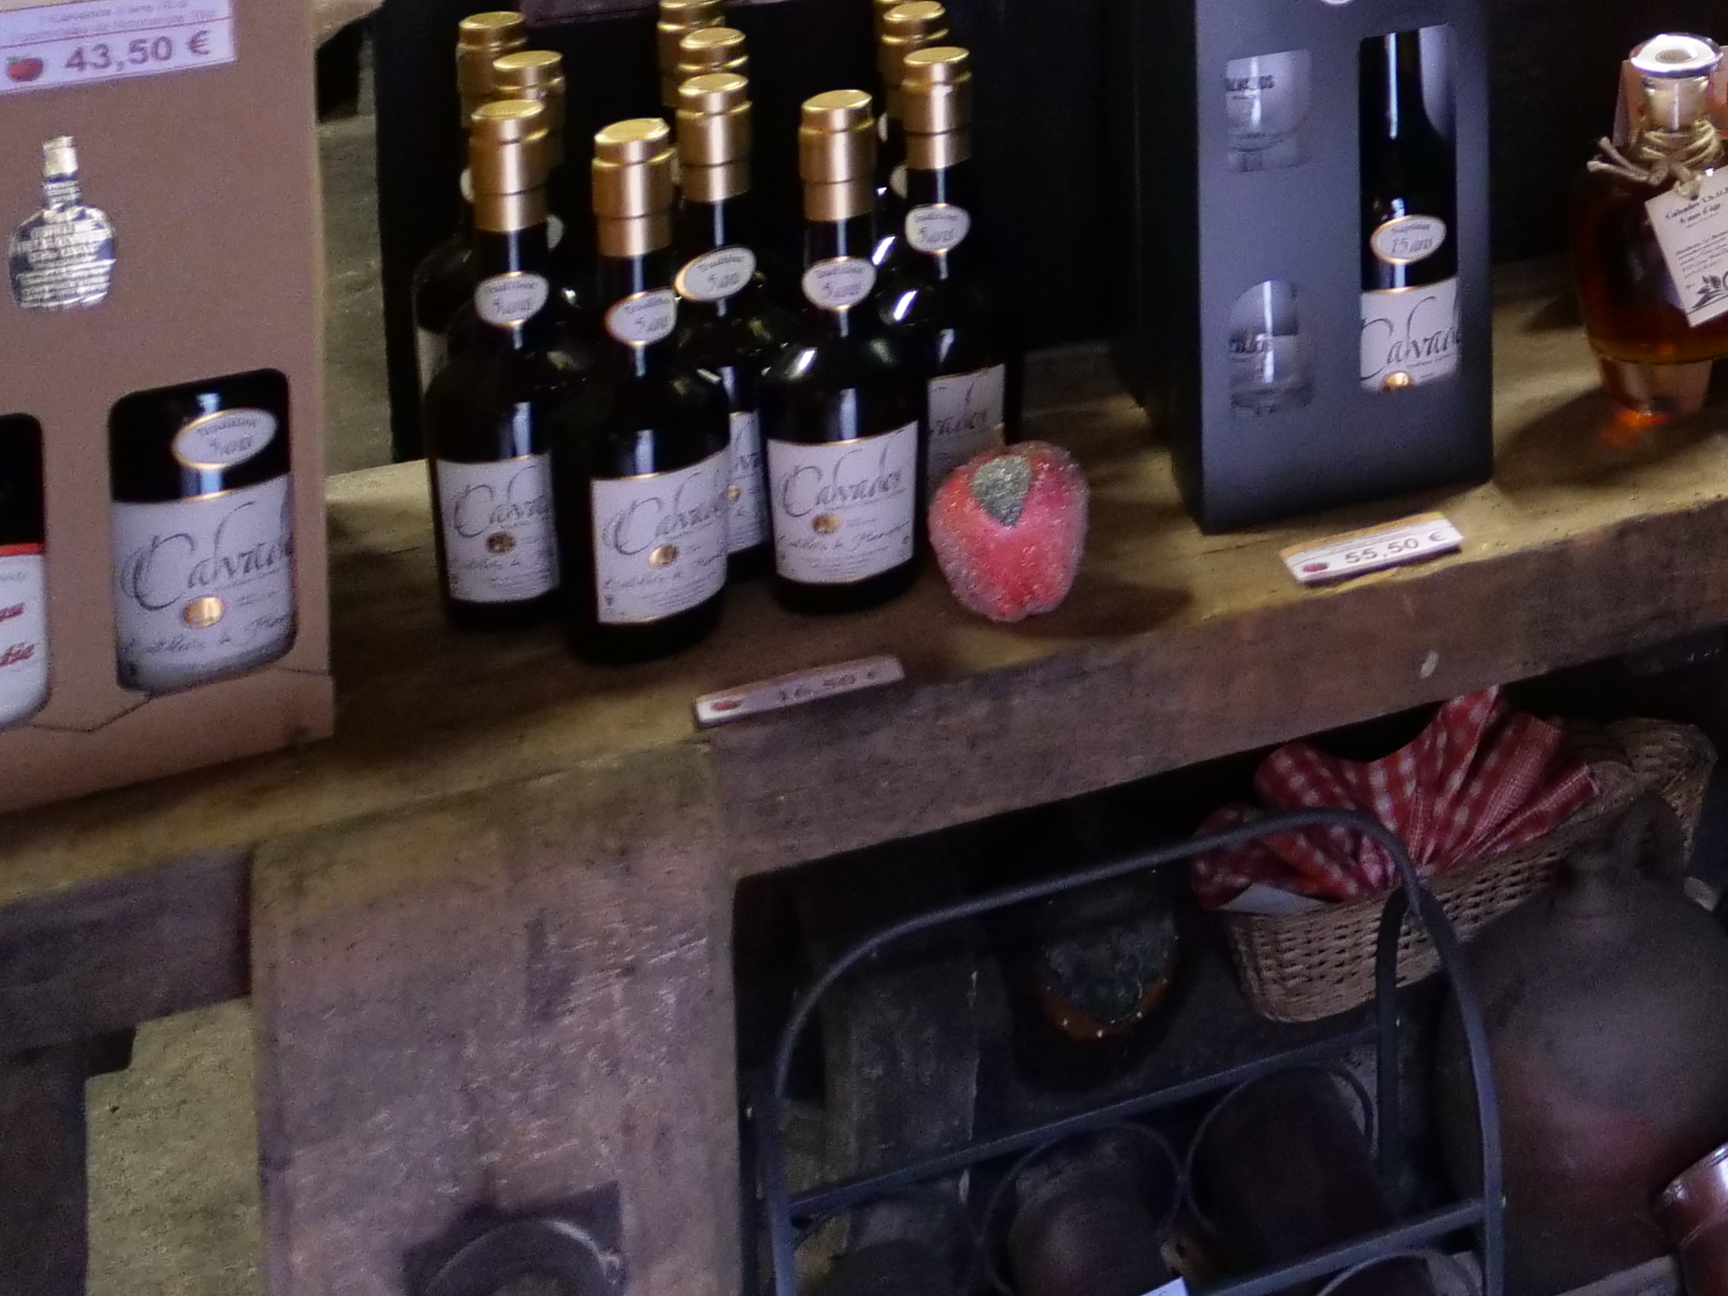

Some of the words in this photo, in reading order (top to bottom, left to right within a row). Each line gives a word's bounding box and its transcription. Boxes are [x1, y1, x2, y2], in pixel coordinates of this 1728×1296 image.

[64, 35, 175, 73] 43,50
[186, 30, 211, 57] €
[1344, 538, 1419, 564] 55,50
